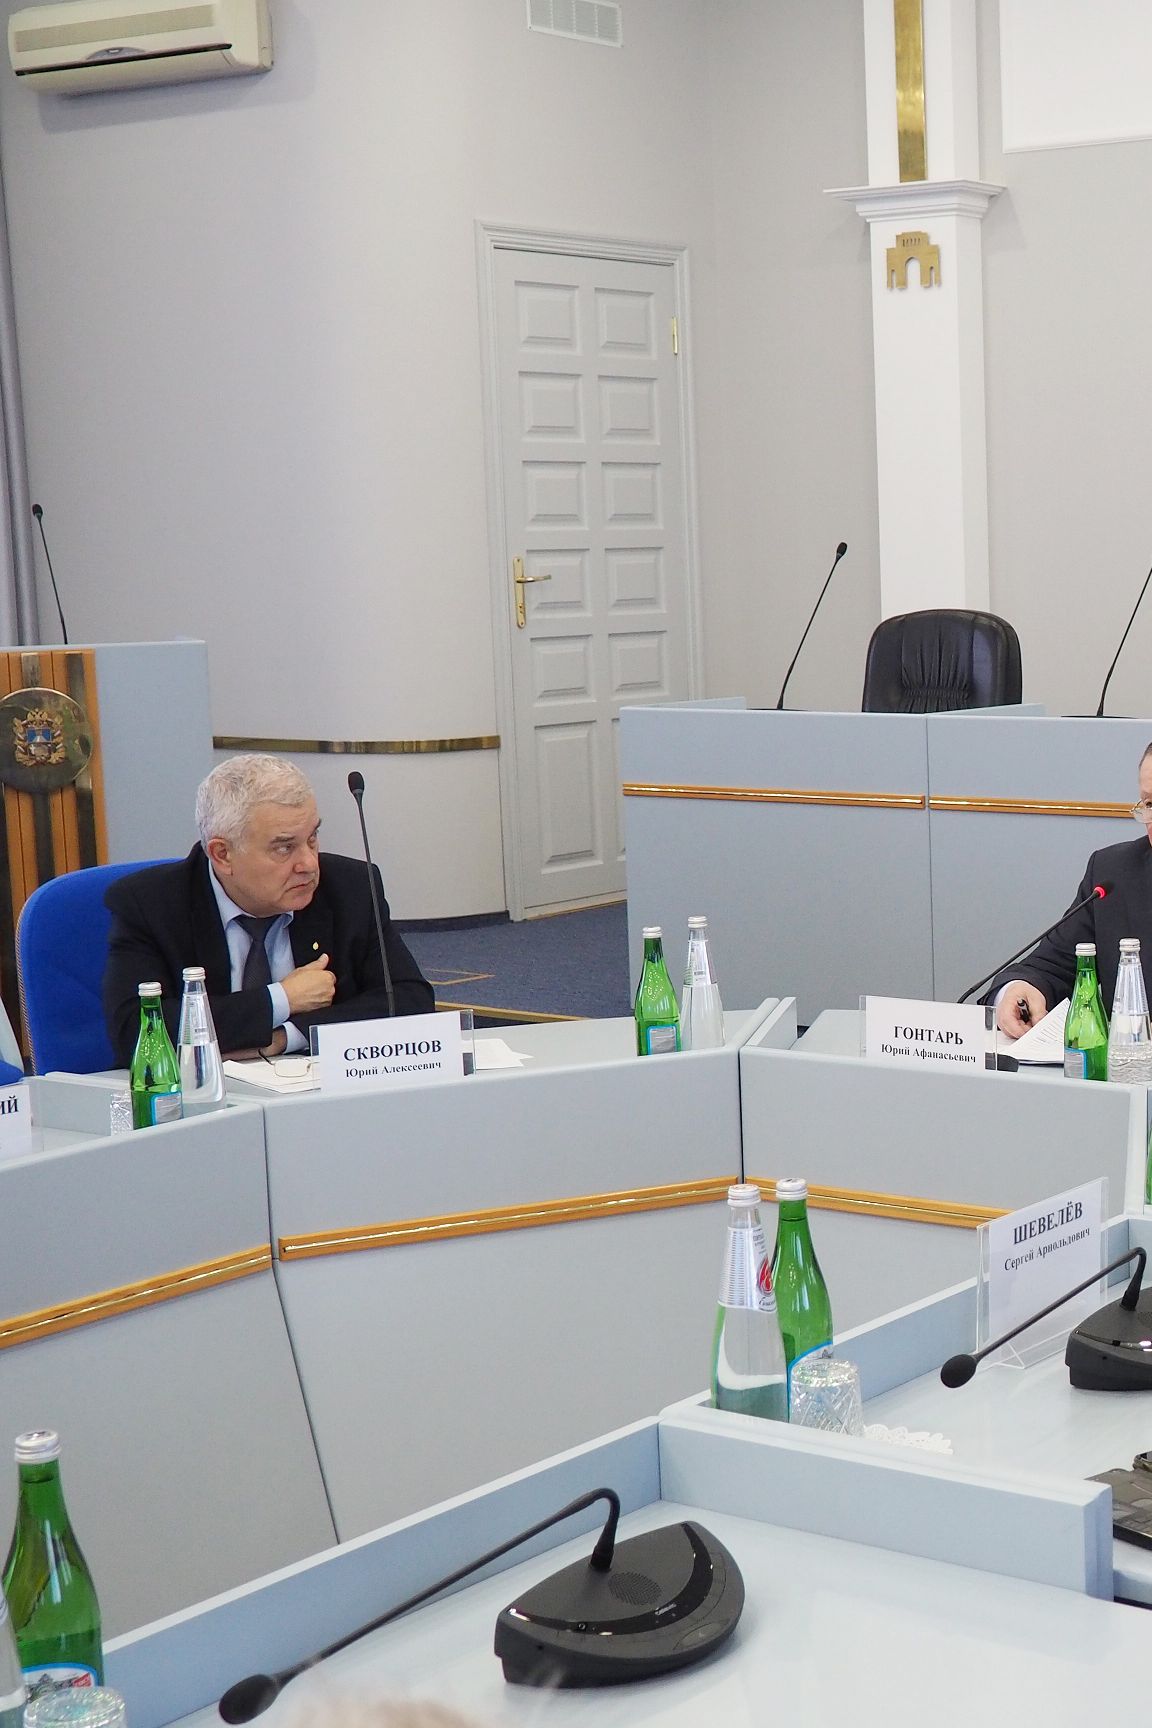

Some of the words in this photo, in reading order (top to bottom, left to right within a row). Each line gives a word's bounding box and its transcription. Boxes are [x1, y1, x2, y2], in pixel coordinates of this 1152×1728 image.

[894, 1025, 964, 1045] ГОНТАРЬ
[343, 1039, 442, 1062] СКВОРЦОВ
[881, 1043, 910, 1057] Юрий
[912, 1047, 977, 1063] Афанасьевич
[345, 1066, 378, 1079] Юрий
[381, 1061, 442, 1075] Алексеевич
[1013, 1200, 1083, 1245] ШЕВЕЛЁВ
[1004, 1249, 1034, 1271] Сергей
[1036, 1227, 1091, 1259] Арнольдович
